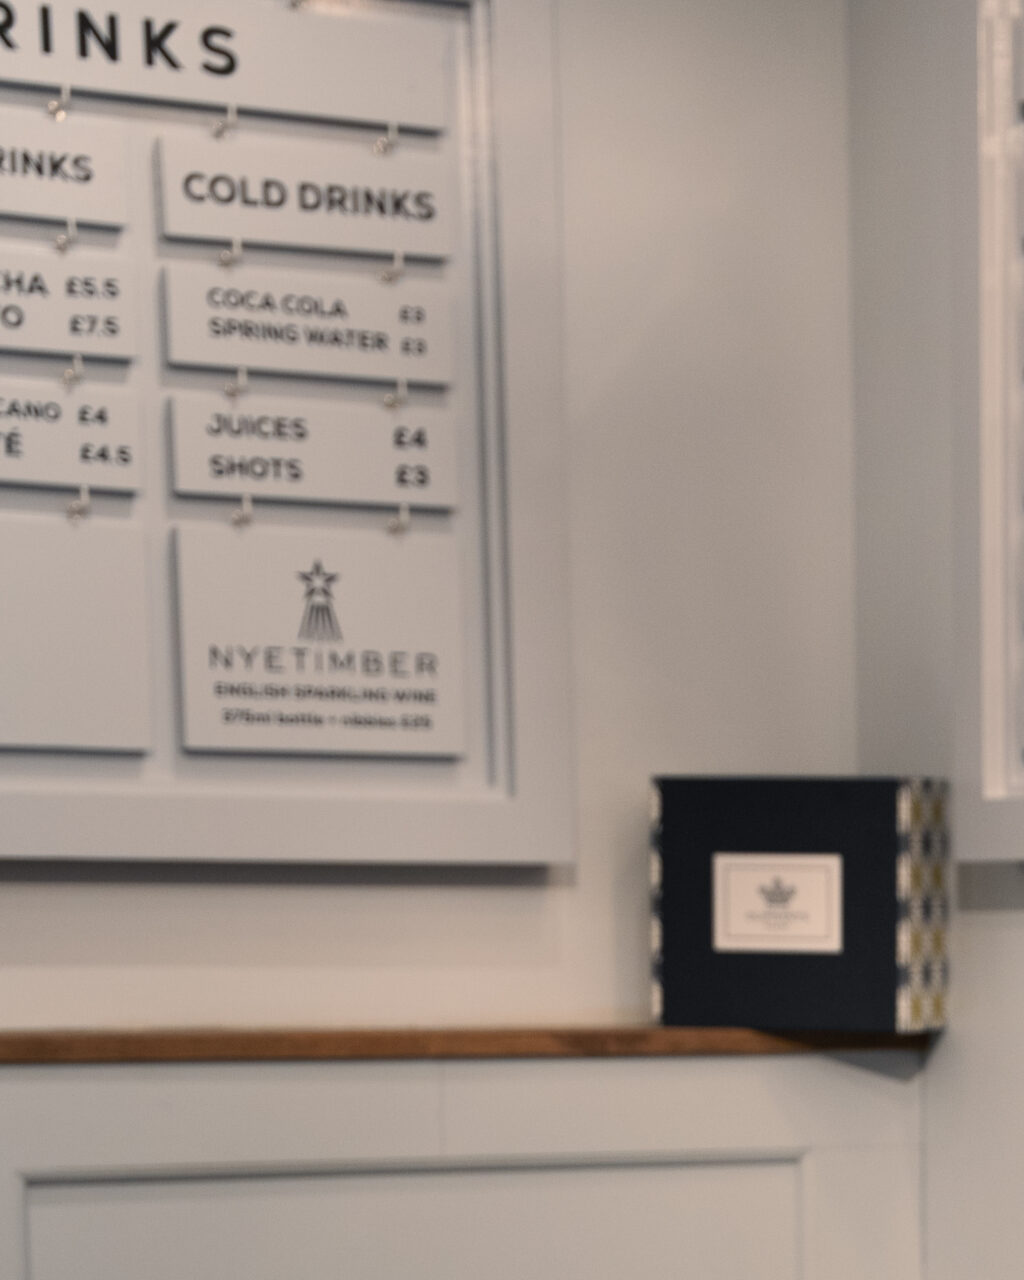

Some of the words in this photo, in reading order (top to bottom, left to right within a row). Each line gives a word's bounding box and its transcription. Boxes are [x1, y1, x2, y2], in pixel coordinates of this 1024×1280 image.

[183, 172, 288, 208] COLD
[298, 181, 436, 221] DRINKS
[0, 271, 49, 297] HA
[206, 286, 278, 311] COCA
[281, 292, 347, 318] COLA
[207, 316, 301, 344] SPRING
[302, 326, 390, 350] WATER
[0, 399, 61, 423] ANO
[79, 404, 108, 425] £4
[0, 426, 22, 458] É
[79, 442, 131, 466] £4.5
[206, 412, 308, 440] JUICES
[394, 426, 428, 449] £4
[208, 454, 303, 482] SHOTS
[396, 464, 431, 487] £3
[208, 645, 438, 677] NYETIMBER
